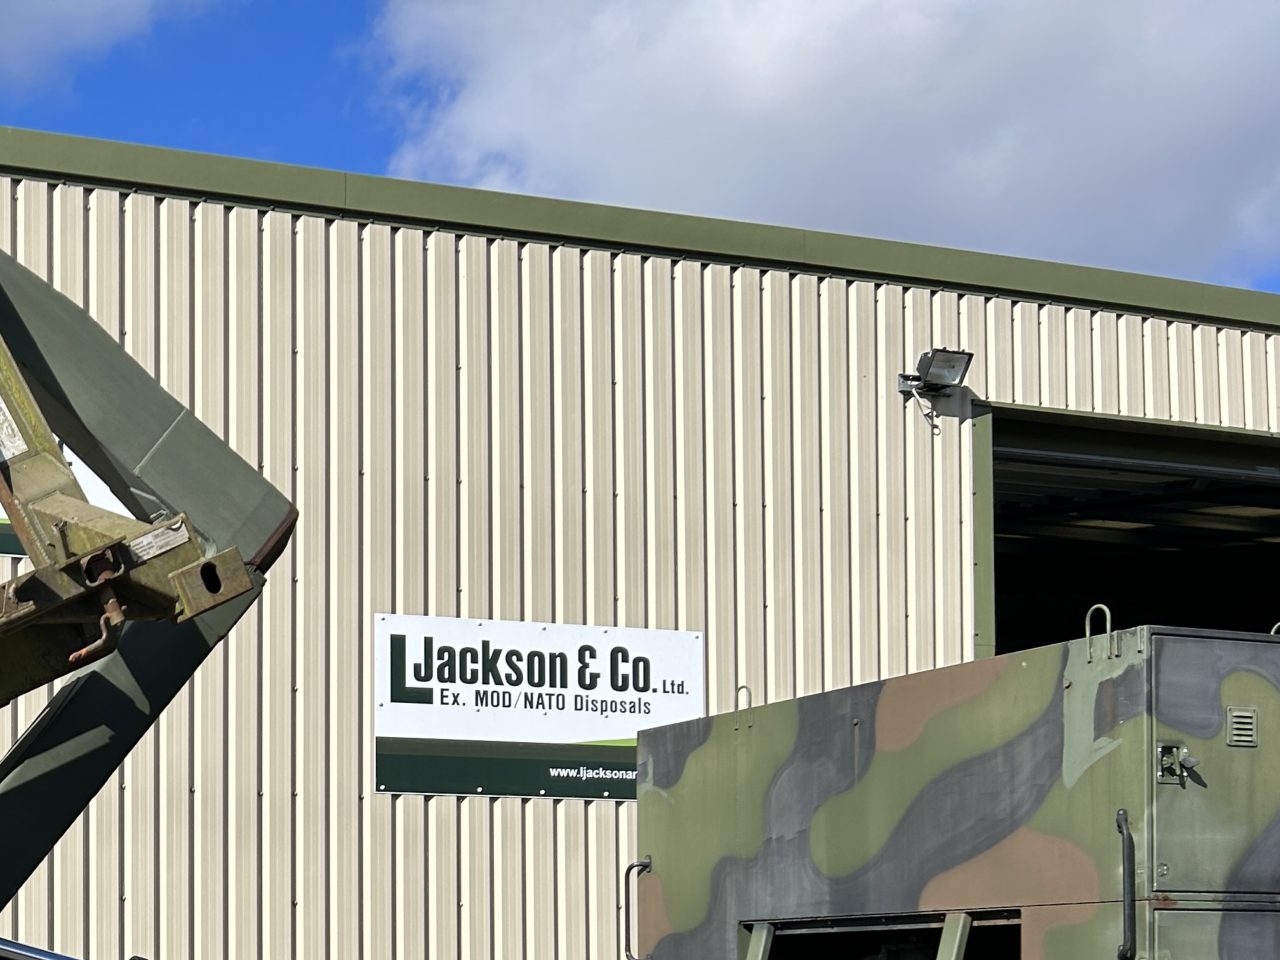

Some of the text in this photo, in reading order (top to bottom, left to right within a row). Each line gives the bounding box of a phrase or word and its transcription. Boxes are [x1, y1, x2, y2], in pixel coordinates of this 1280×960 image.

[577, 644, 601, 690] &
[609, 646, 658, 693] Co.
[662, 679, 689, 695] Ltd.
[440, 688, 651, 715] Ex. MOD/NATO Disposals
